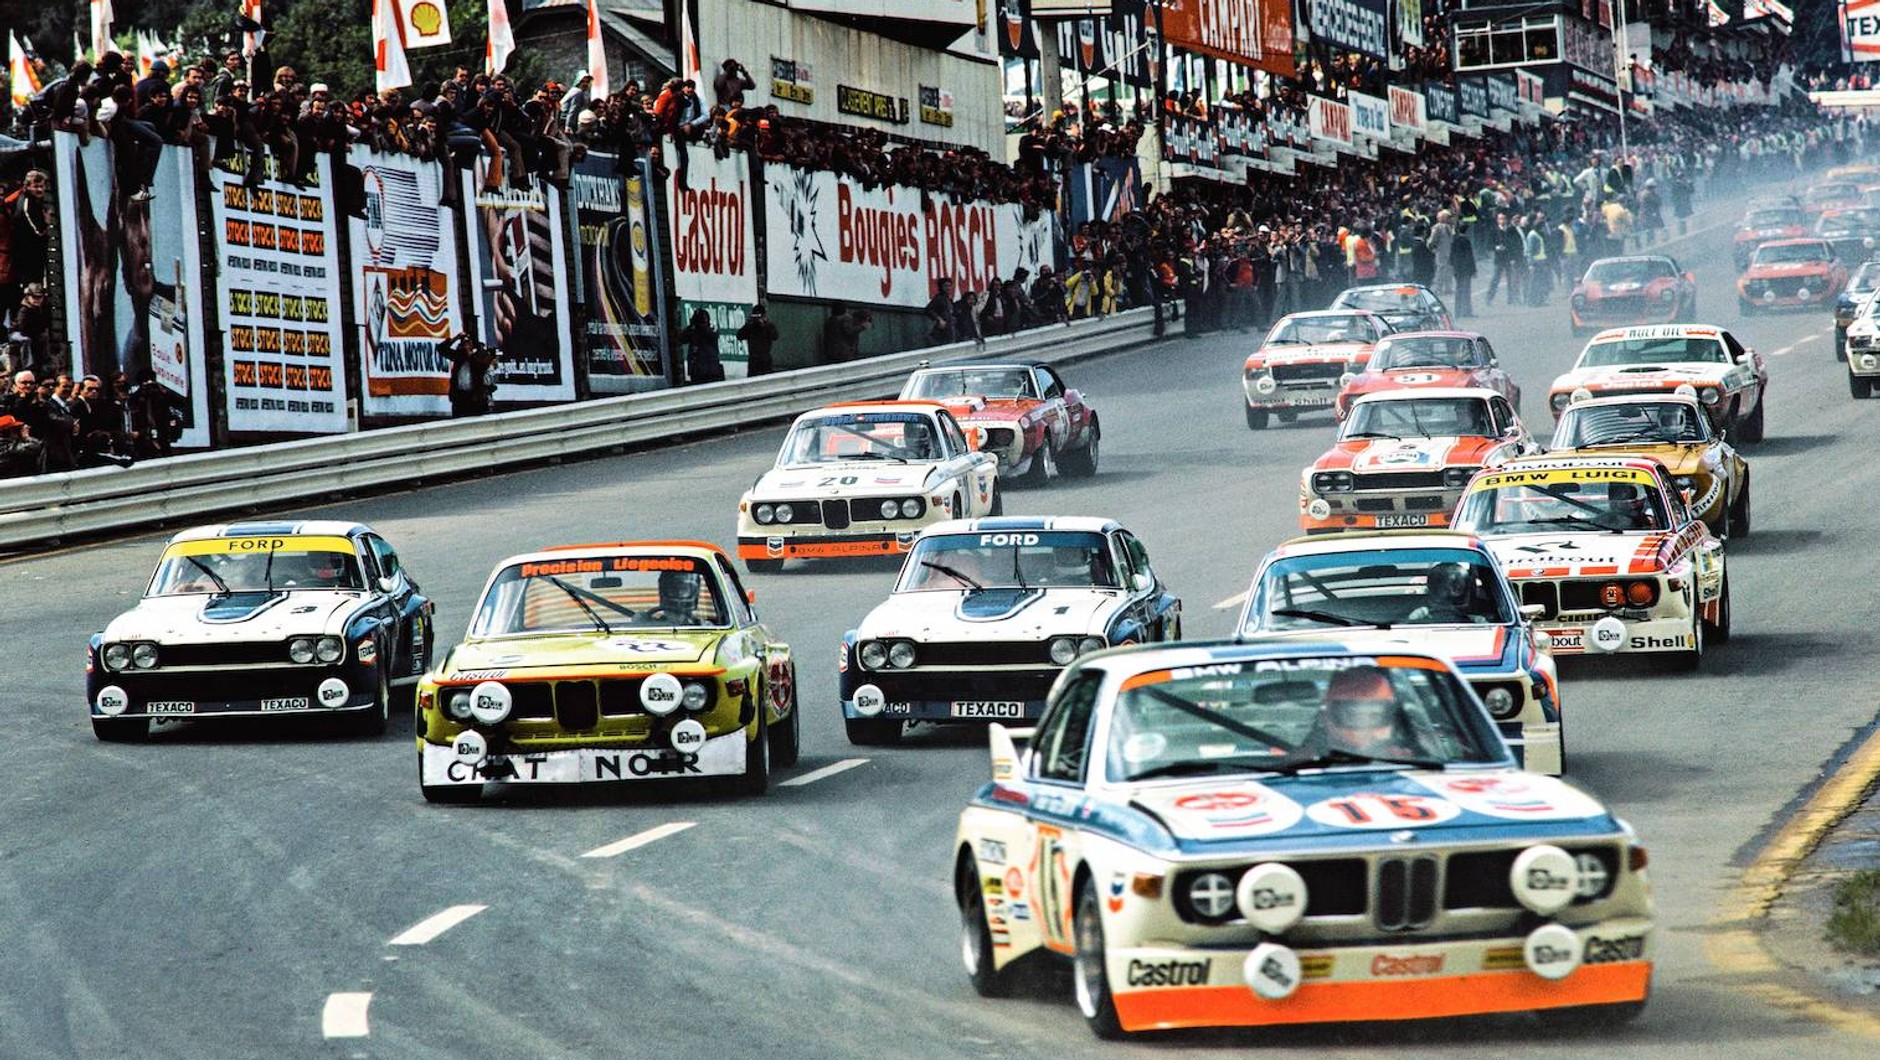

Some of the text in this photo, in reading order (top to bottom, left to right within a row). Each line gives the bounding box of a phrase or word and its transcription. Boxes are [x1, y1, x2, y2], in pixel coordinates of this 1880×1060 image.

[673, 168, 745, 276] Castrol
[838, 183, 998, 299] Bougies BOSCH
[817, 476, 858, 486] 20
[1485, 470, 1637, 486] BMW LUIGI
[1377, 514, 1427, 526] TEXACO
[228, 538, 285, 551] FORD
[979, 533, 1040, 547] FORD
[1551, 634, 1582, 647] bout
[1630, 635, 1685, 649] Shell
[149, 702, 193, 713] TEXACO
[263, 698, 307, 710] TEXACO
[882, 702, 908, 714] ACO
[956, 702, 1019, 716] TEXACO
[1328, 795, 1438, 824] 15
[1126, 957, 1212, 987] Castrol
[1371, 953, 1444, 977] Castrol
